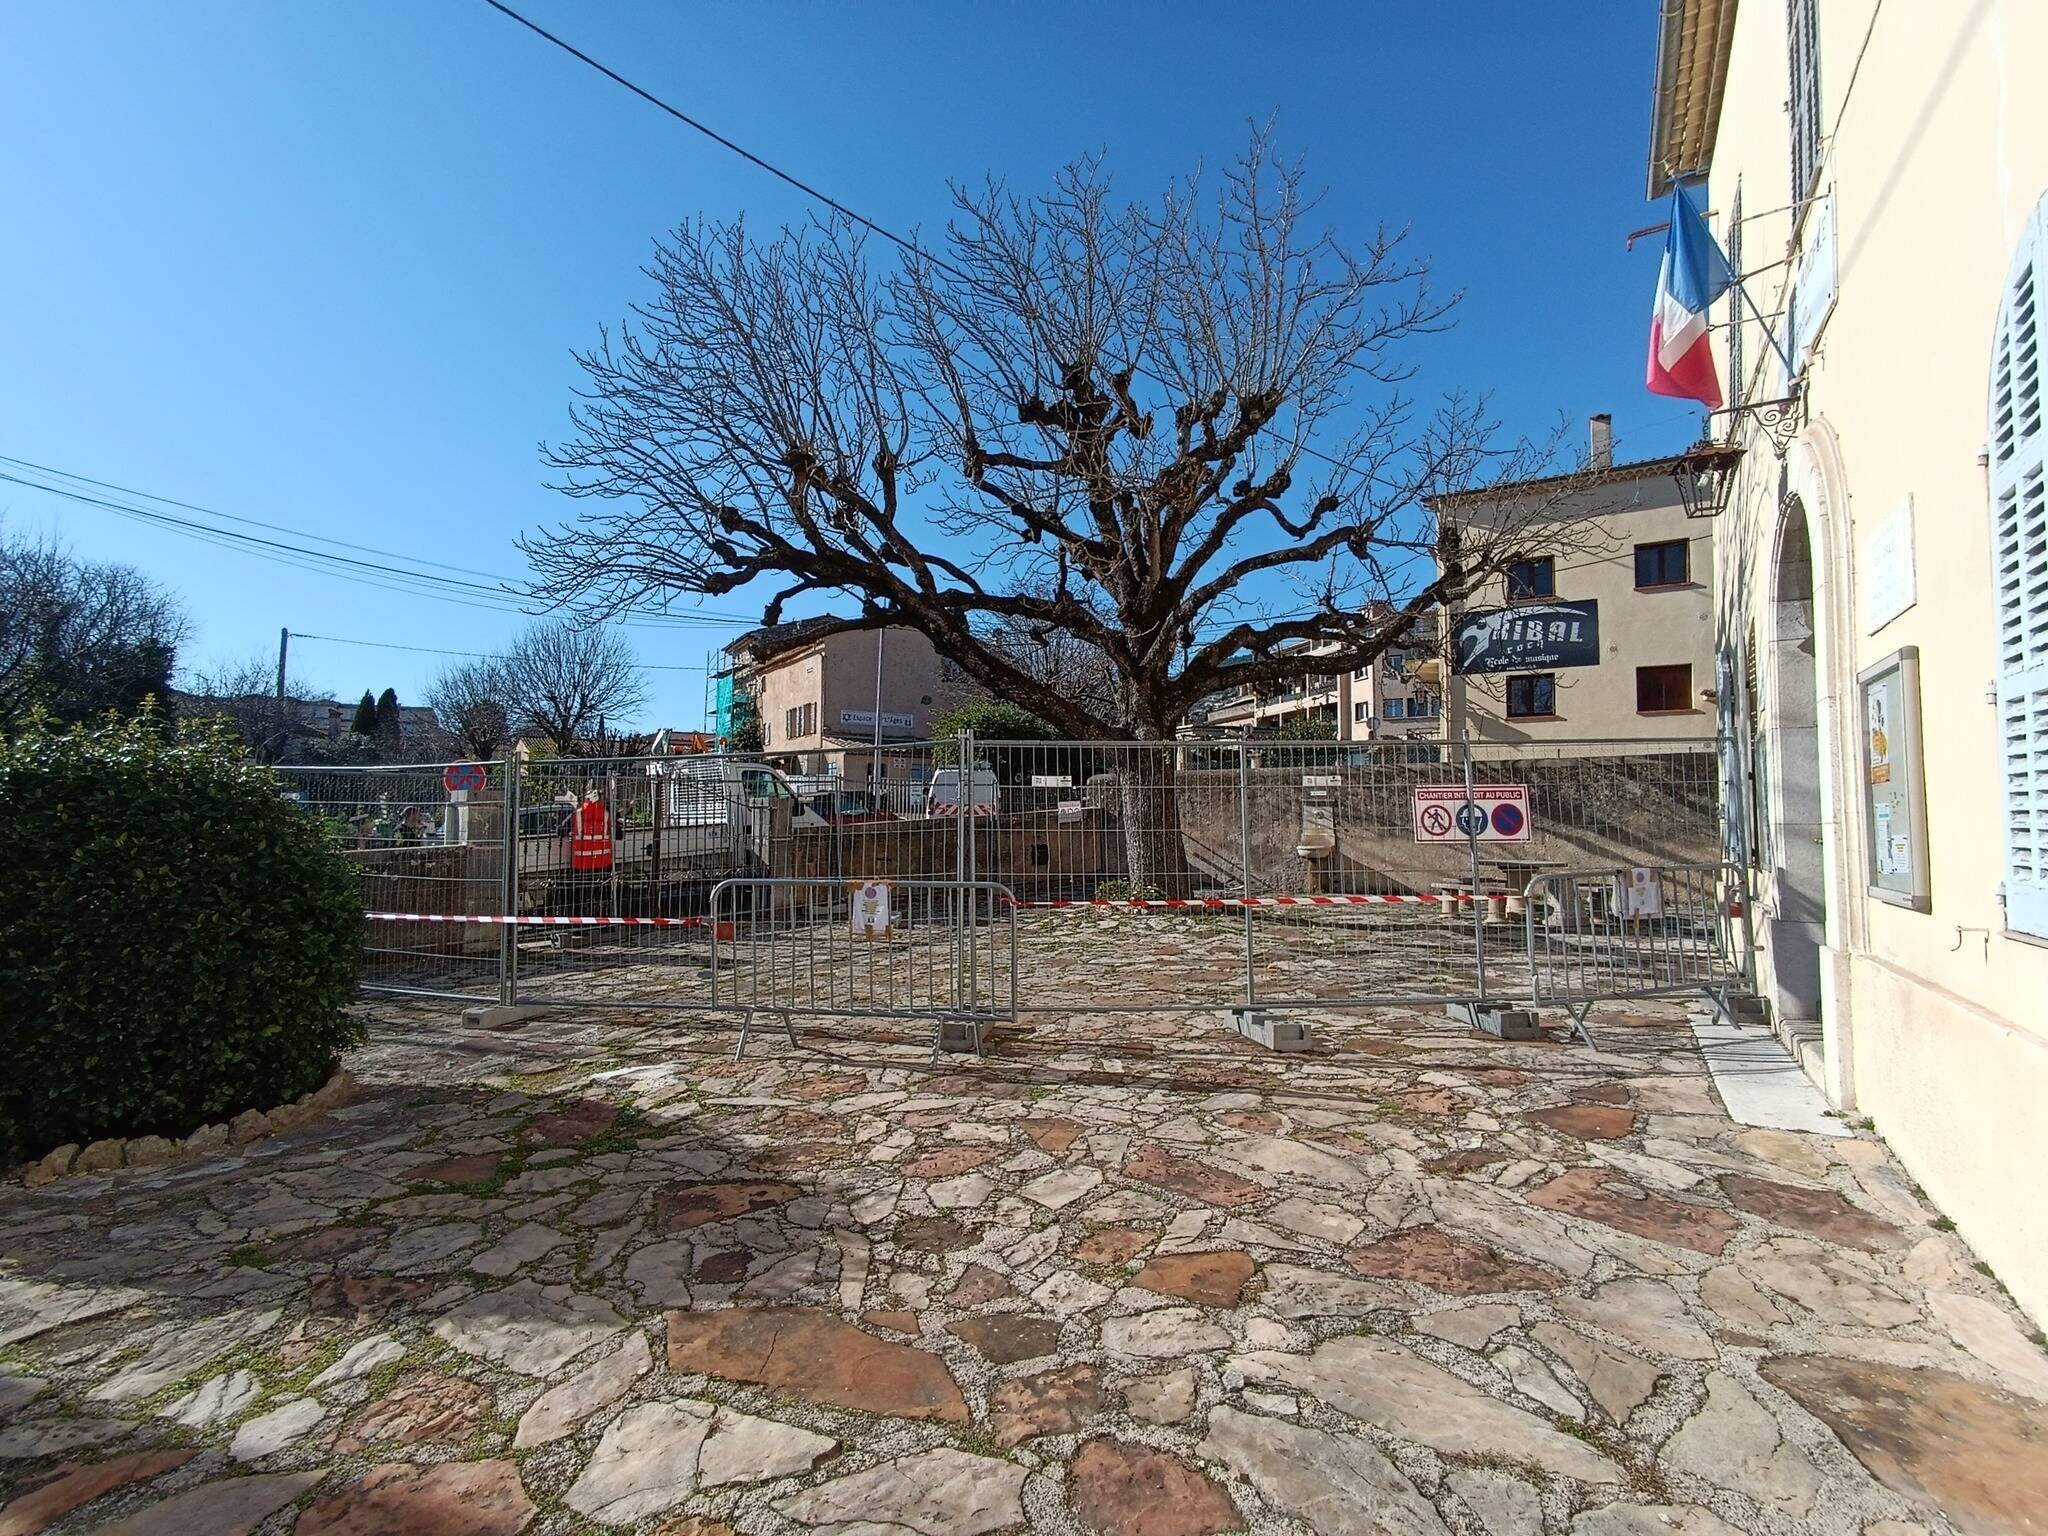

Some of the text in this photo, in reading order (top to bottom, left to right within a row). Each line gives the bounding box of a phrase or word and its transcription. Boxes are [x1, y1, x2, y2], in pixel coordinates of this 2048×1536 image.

[1419, 791, 1453, 800] CHANTIER
[1485, 791, 1495, 799] AU
[1495, 791, 1521, 799] PUBLIC
